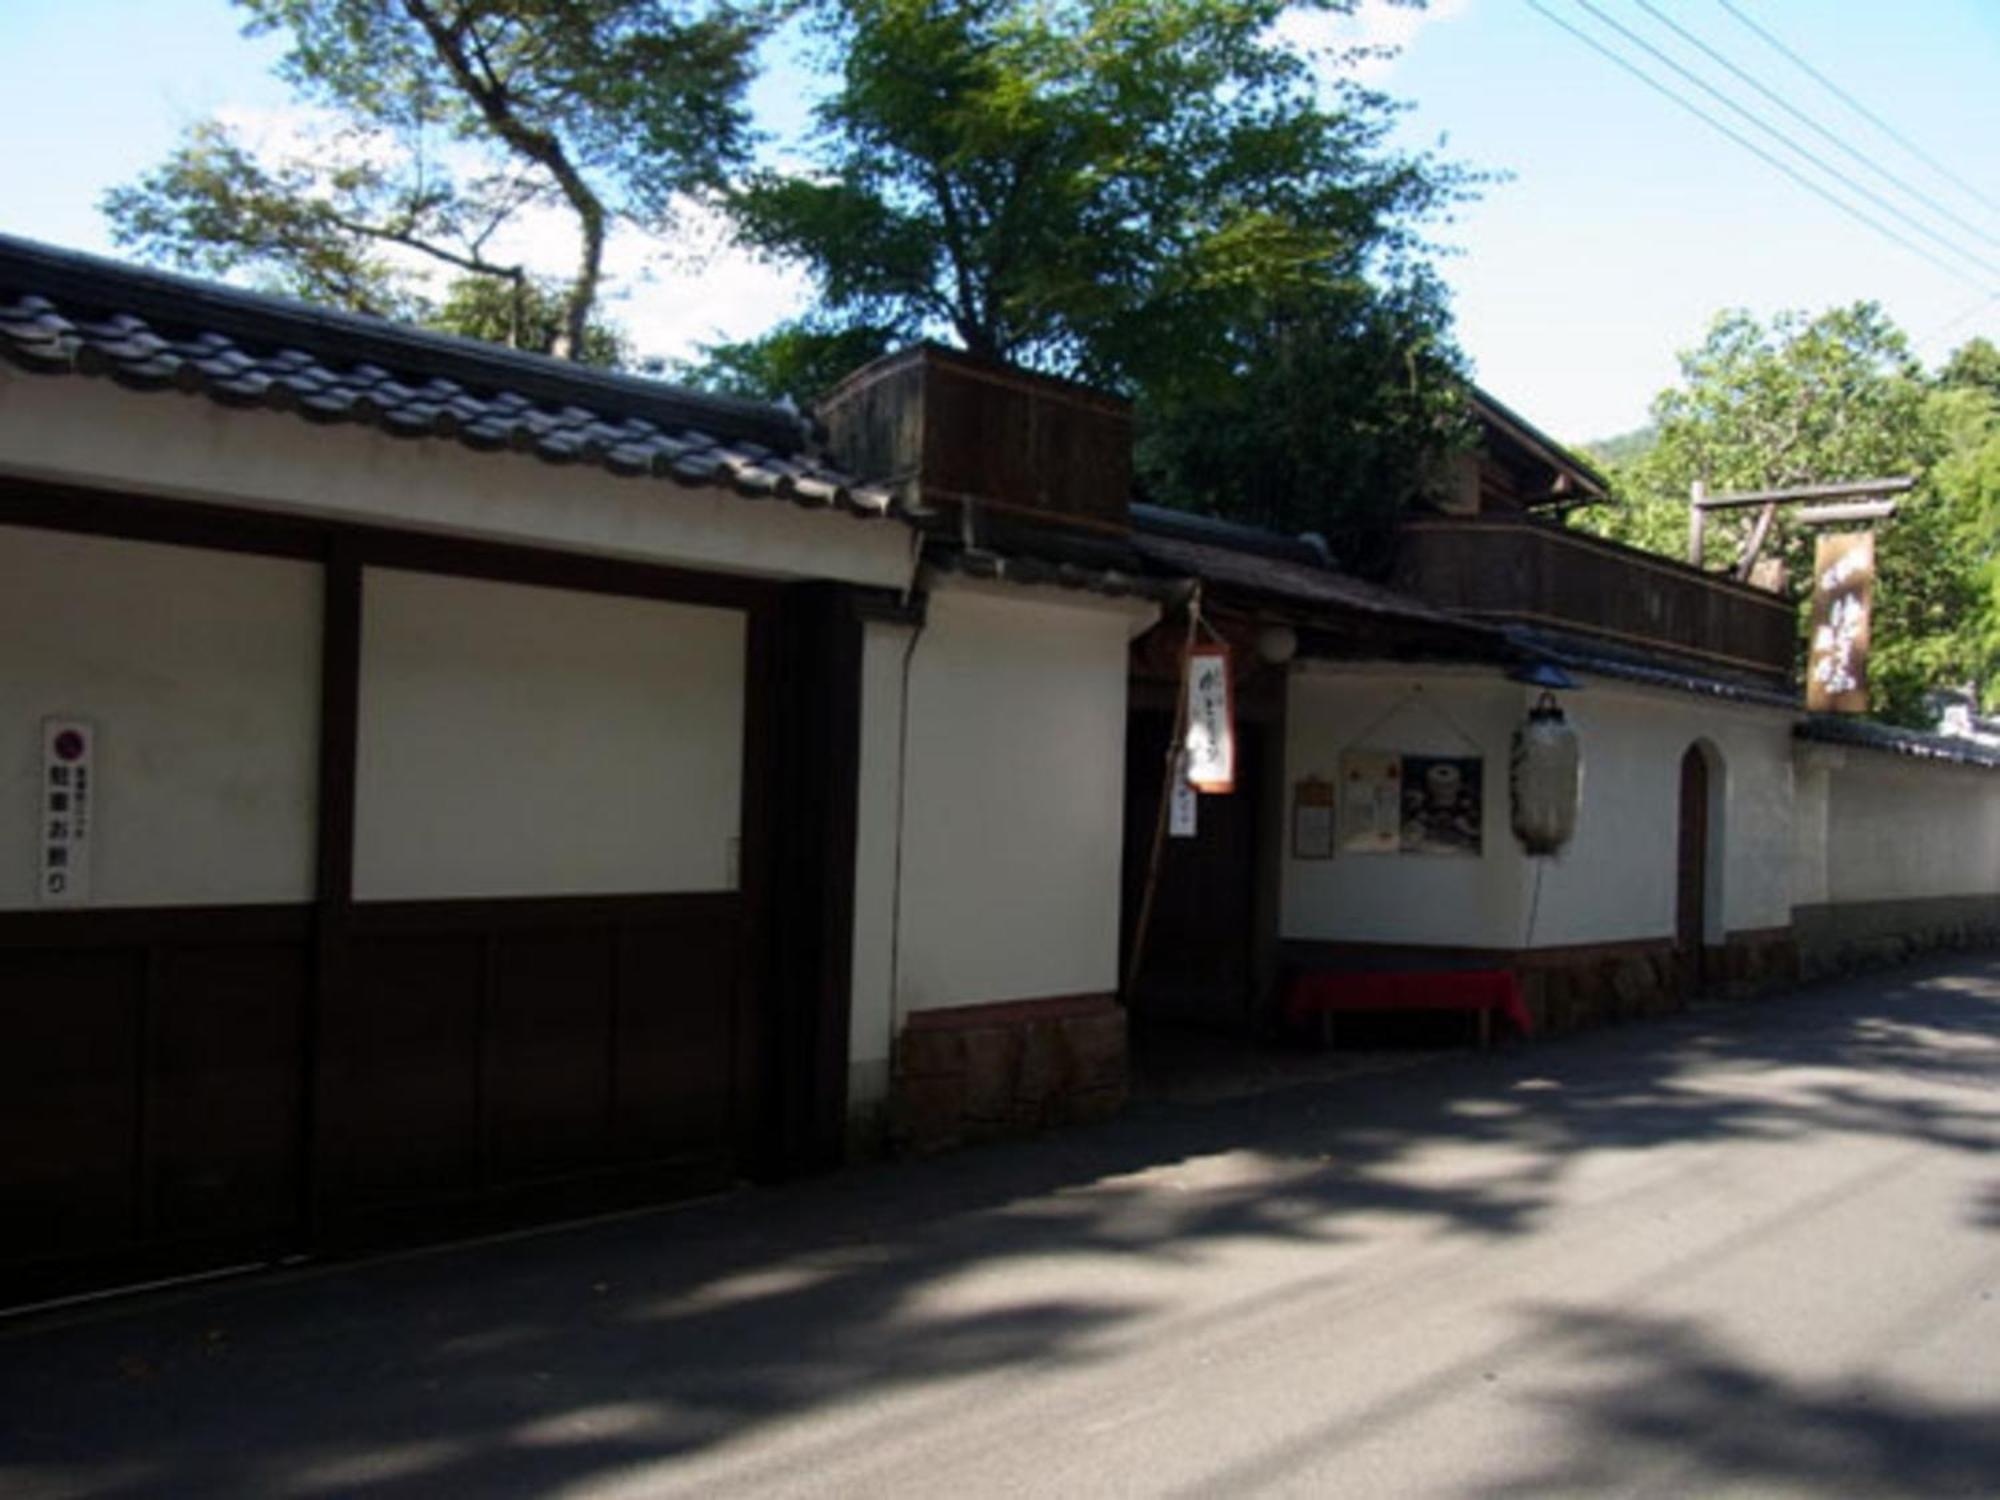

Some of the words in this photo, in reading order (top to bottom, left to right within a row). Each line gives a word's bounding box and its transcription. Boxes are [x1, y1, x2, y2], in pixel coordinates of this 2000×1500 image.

[48, 765, 69, 893] 駐車お断り
